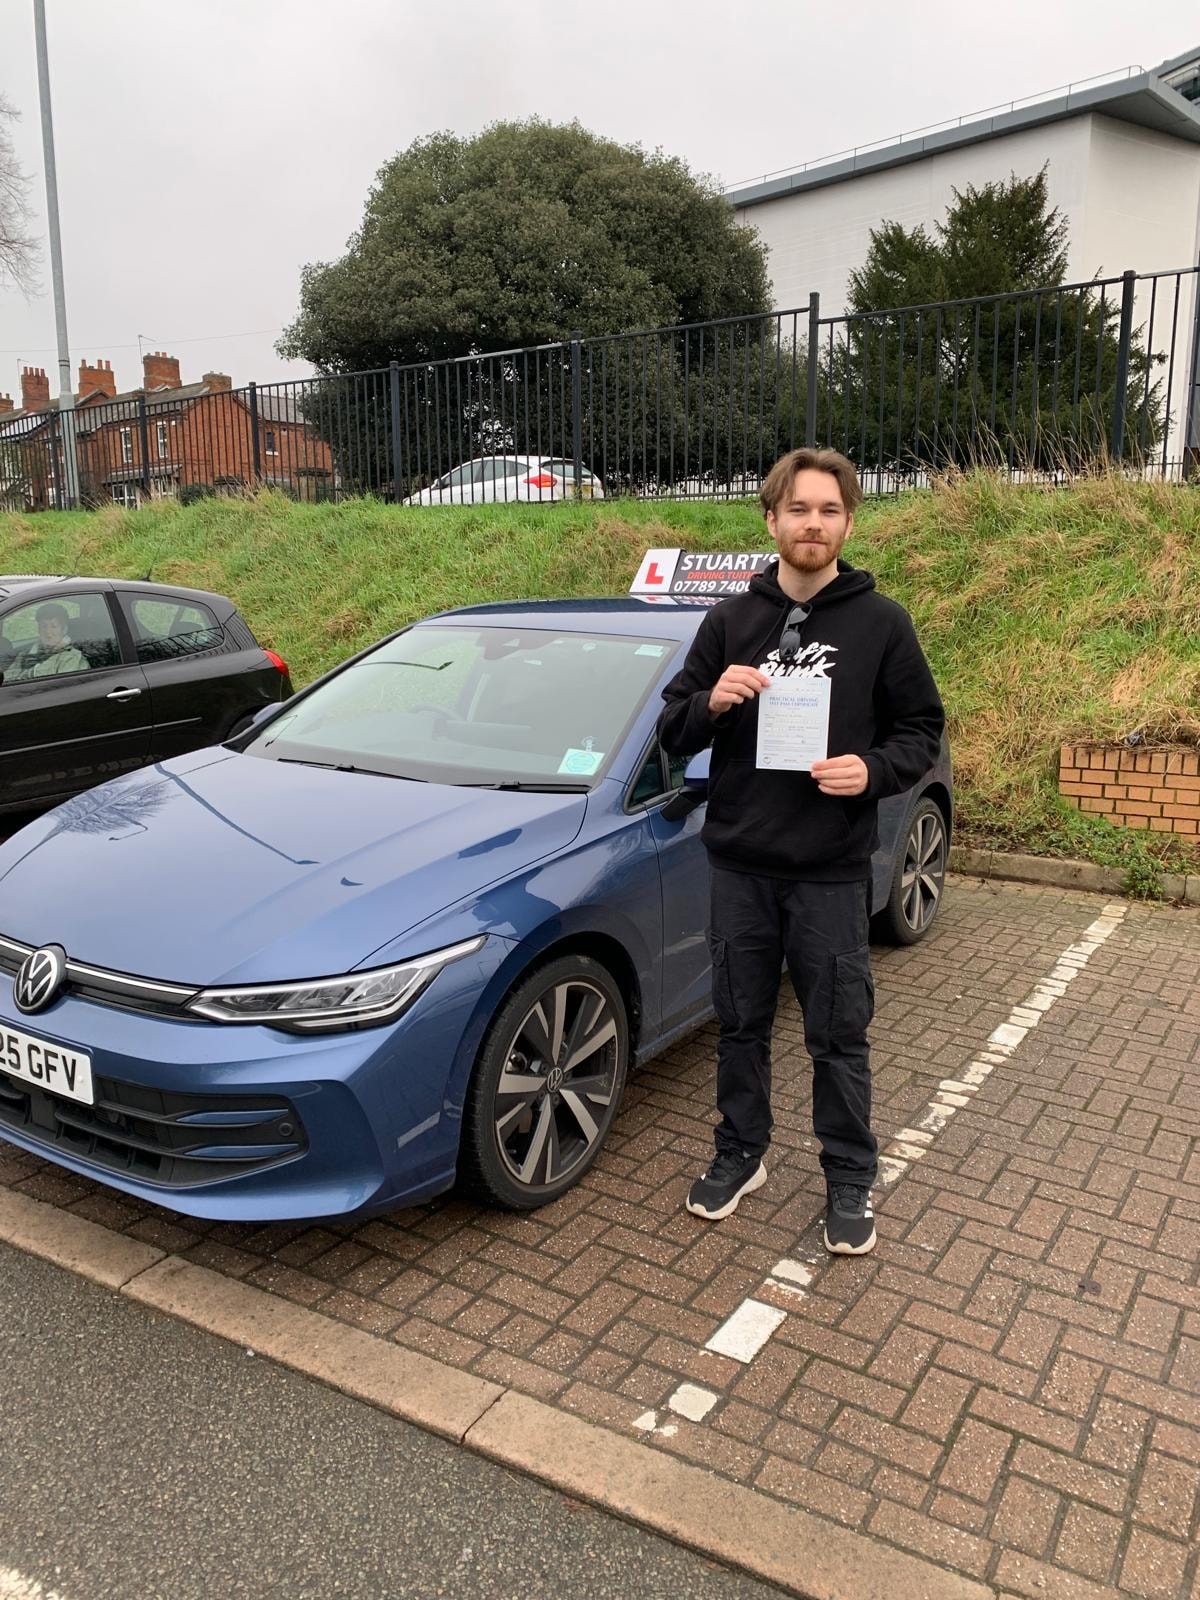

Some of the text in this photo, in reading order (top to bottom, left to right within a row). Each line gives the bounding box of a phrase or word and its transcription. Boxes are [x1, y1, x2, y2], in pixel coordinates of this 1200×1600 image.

[645, 562, 664, 584] L
[687, 571, 753, 579] DRIVING TUITI
[674, 580, 716, 592] 07789
[27, 1043, 77, 1092] GFV
